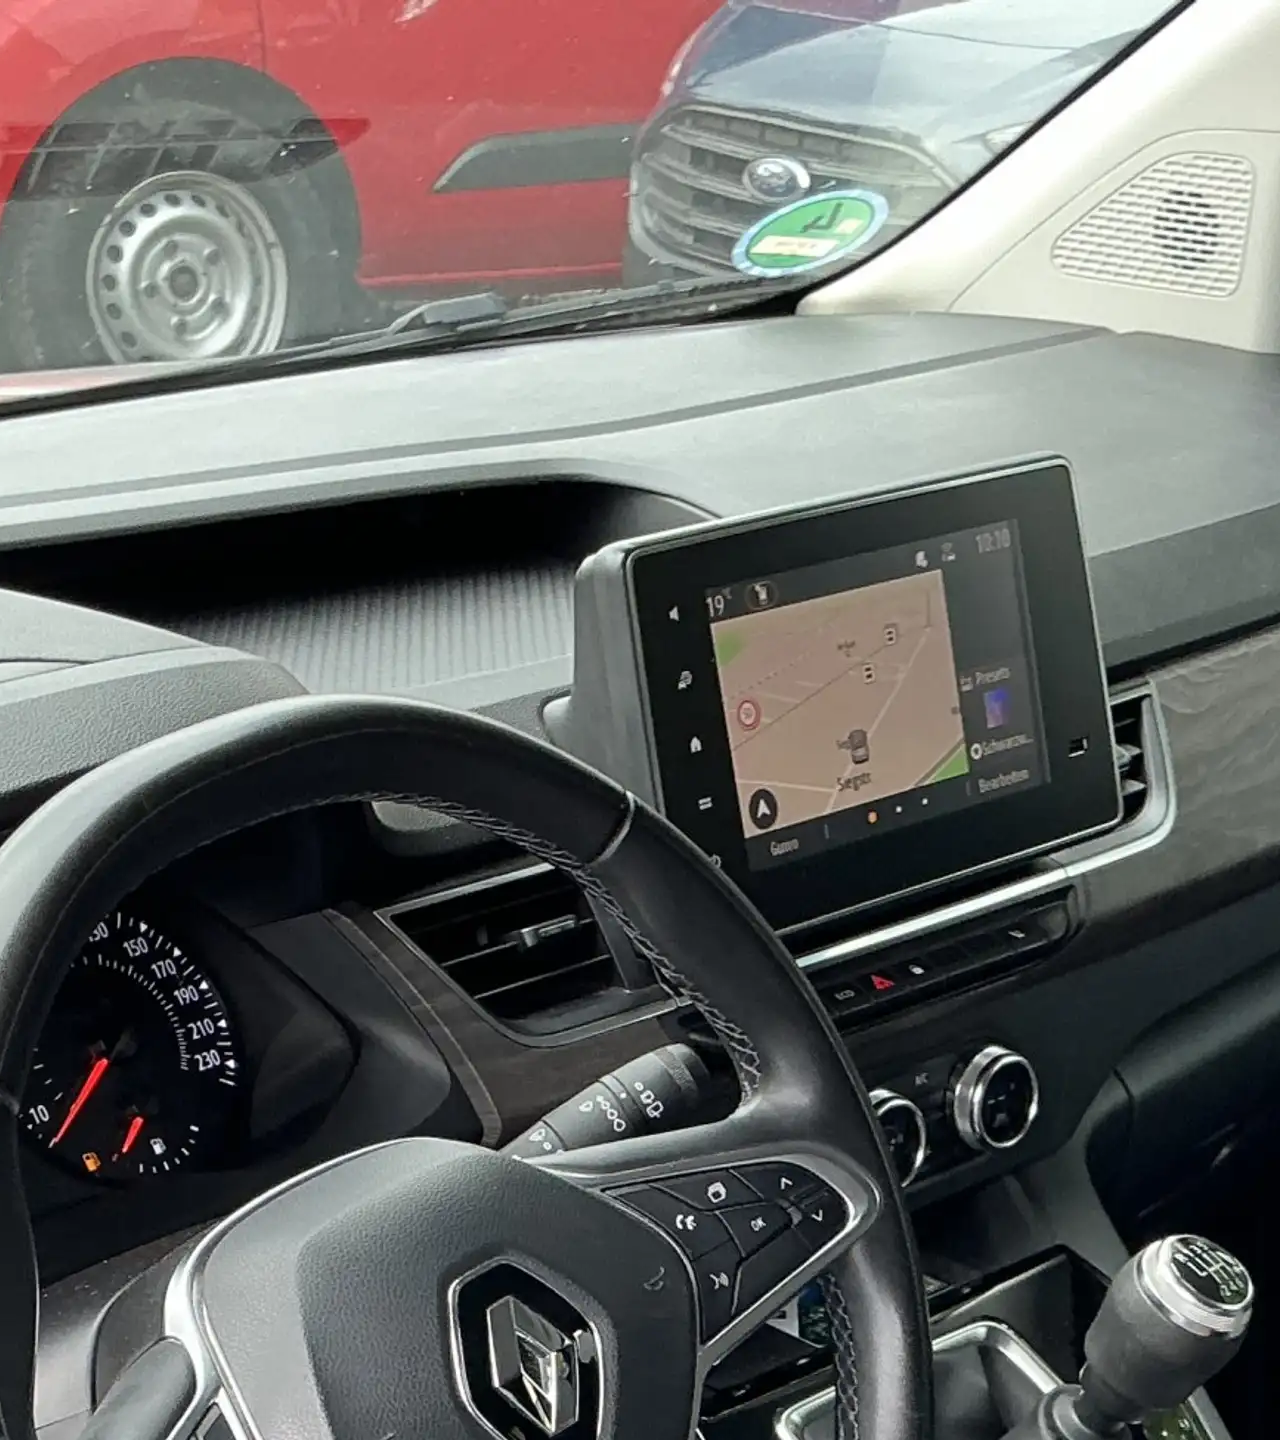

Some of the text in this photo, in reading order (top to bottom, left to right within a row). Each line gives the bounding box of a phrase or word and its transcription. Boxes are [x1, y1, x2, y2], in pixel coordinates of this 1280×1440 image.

[88, 921, 109, 942] 30
[122, 937, 149, 958] 150
[151, 959, 177, 980] 170
[173, 985, 199, 1006] 190
[187, 1018, 215, 1040] 210
[194, 1049, 221, 1072] 230
[28, 1104, 50, 1125] 10
[750, 1216, 767, 1232] OK
